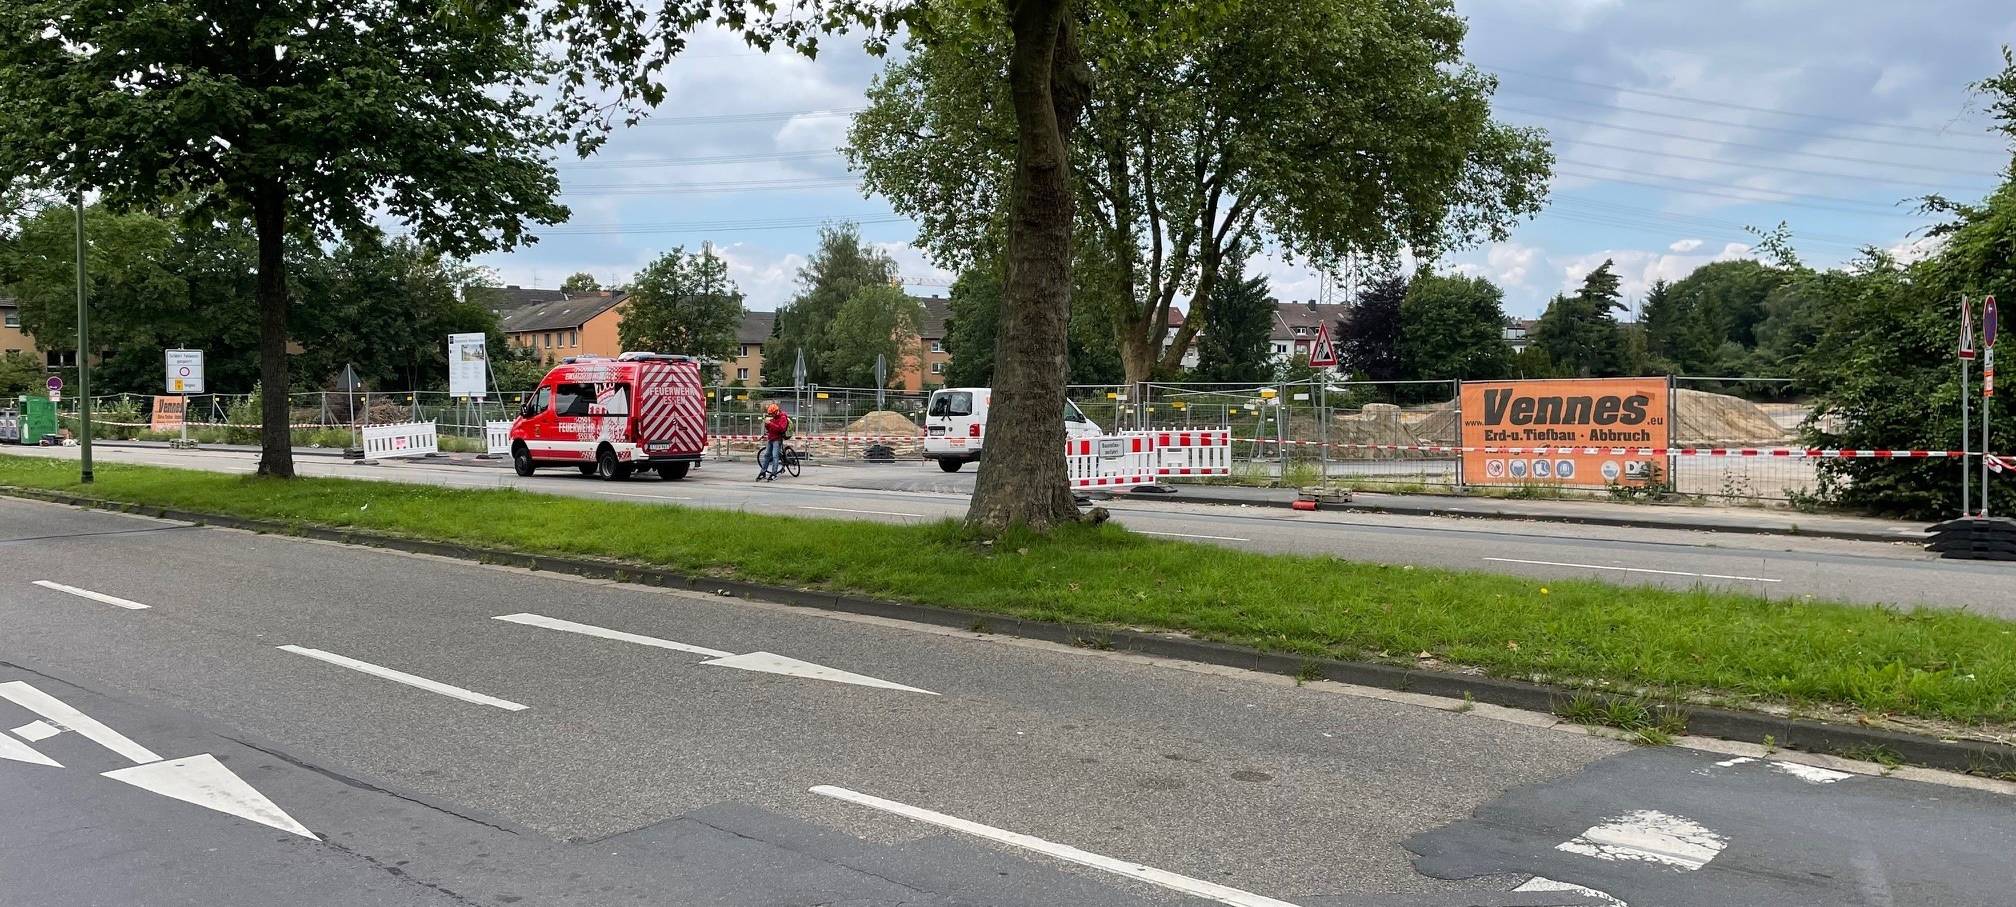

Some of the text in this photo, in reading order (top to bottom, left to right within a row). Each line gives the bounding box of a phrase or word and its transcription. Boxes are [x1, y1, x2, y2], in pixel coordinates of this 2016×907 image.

[649, 387, 695, 396] FEUERWEHR
[664, 396, 686, 405] ESSEN
[559, 422, 596, 432] FEUERWEHR
[1589, 429, 1650, 442] Abbruch
